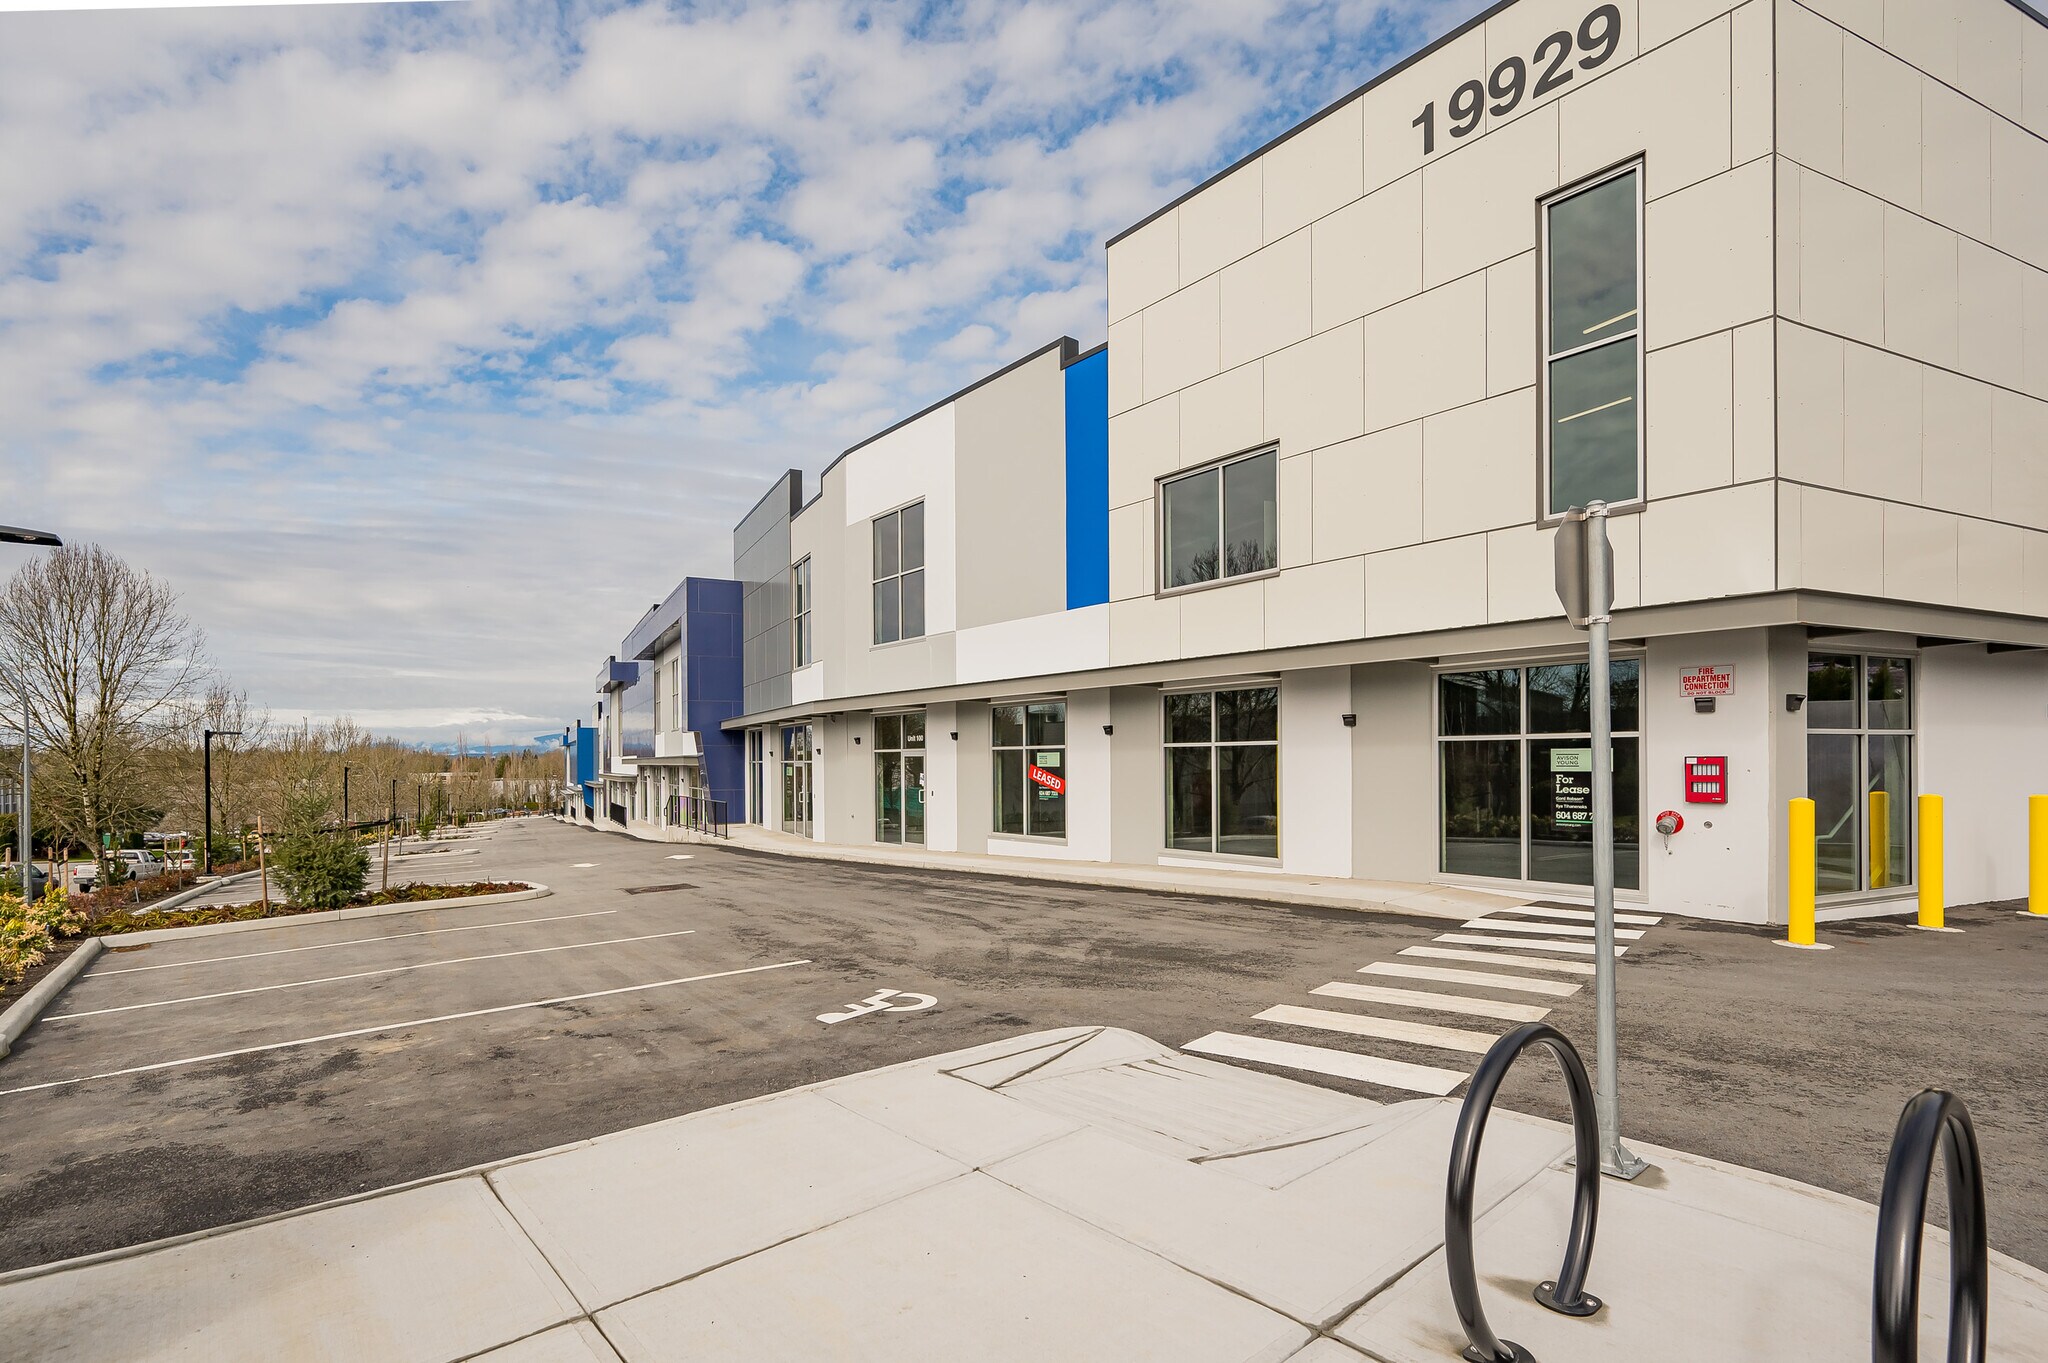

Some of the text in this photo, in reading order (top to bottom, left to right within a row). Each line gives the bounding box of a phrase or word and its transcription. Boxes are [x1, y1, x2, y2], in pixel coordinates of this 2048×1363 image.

[1412, 4, 1621, 155] 19929
[1698, 667, 1714, 675] FIRE
[1683, 674, 1730, 683] DEPARTMENT
[1684, 682, 1729, 690] CONNECTION
[1033, 768, 1061, 789] LEASED
[1556, 774, 1574, 784] For
[1556, 784, 1590, 794] Lease
[1556, 811, 1571, 819] 604
[1572, 811, 1588, 820] 687
